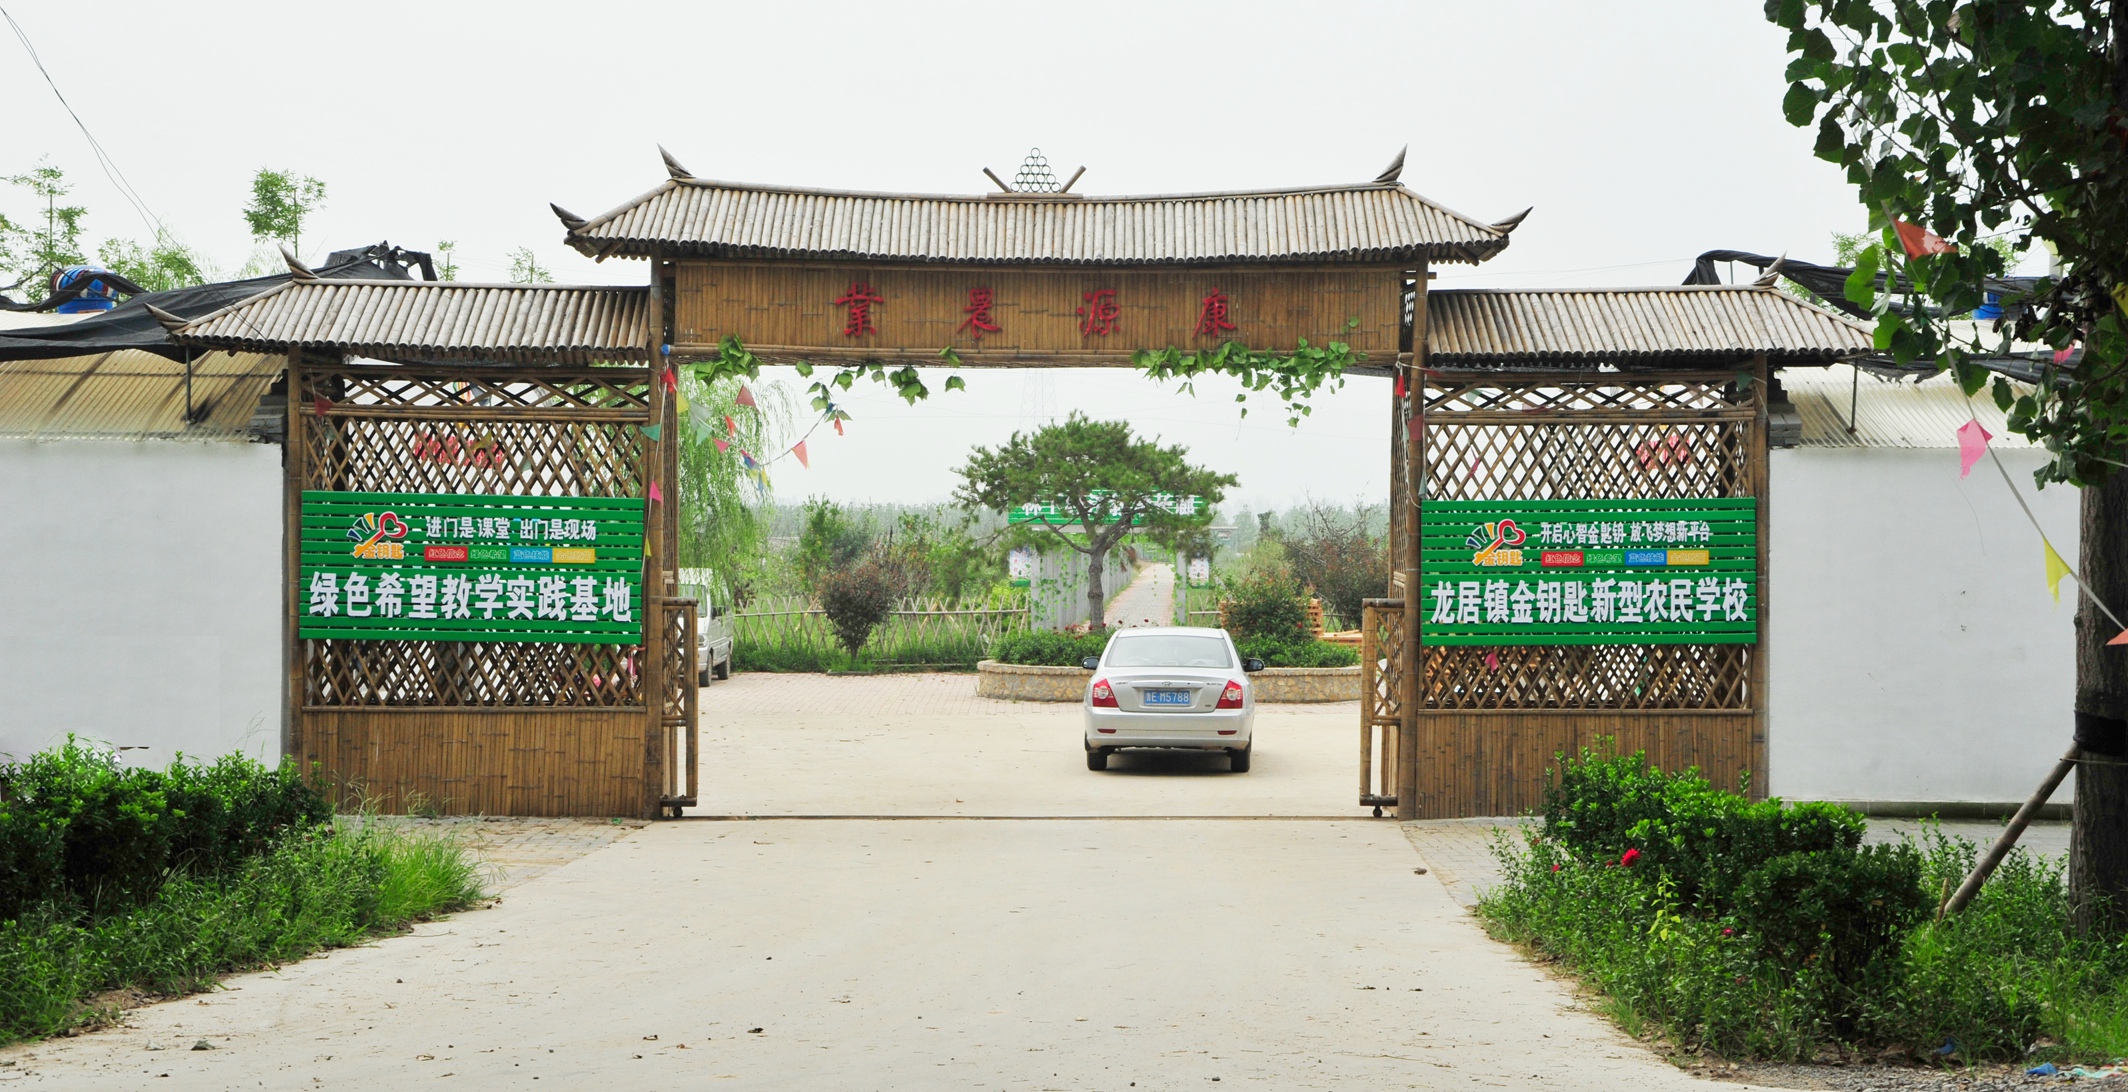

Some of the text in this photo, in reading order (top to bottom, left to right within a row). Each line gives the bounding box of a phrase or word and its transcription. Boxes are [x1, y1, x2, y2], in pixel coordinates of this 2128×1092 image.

[426, 516, 597, 541] 进门是课堂 出门是现场
[1630, 521, 1711, 543] 放飞梦想新平台
[362, 542, 405, 560] 金钥匙
[1481, 549, 1523, 567] 金钥匙
[309, 571, 632, 622] 绿色希望教学实践基地
[1431, 577, 1748, 624] 龙居镇金钥匙新型农民学校
